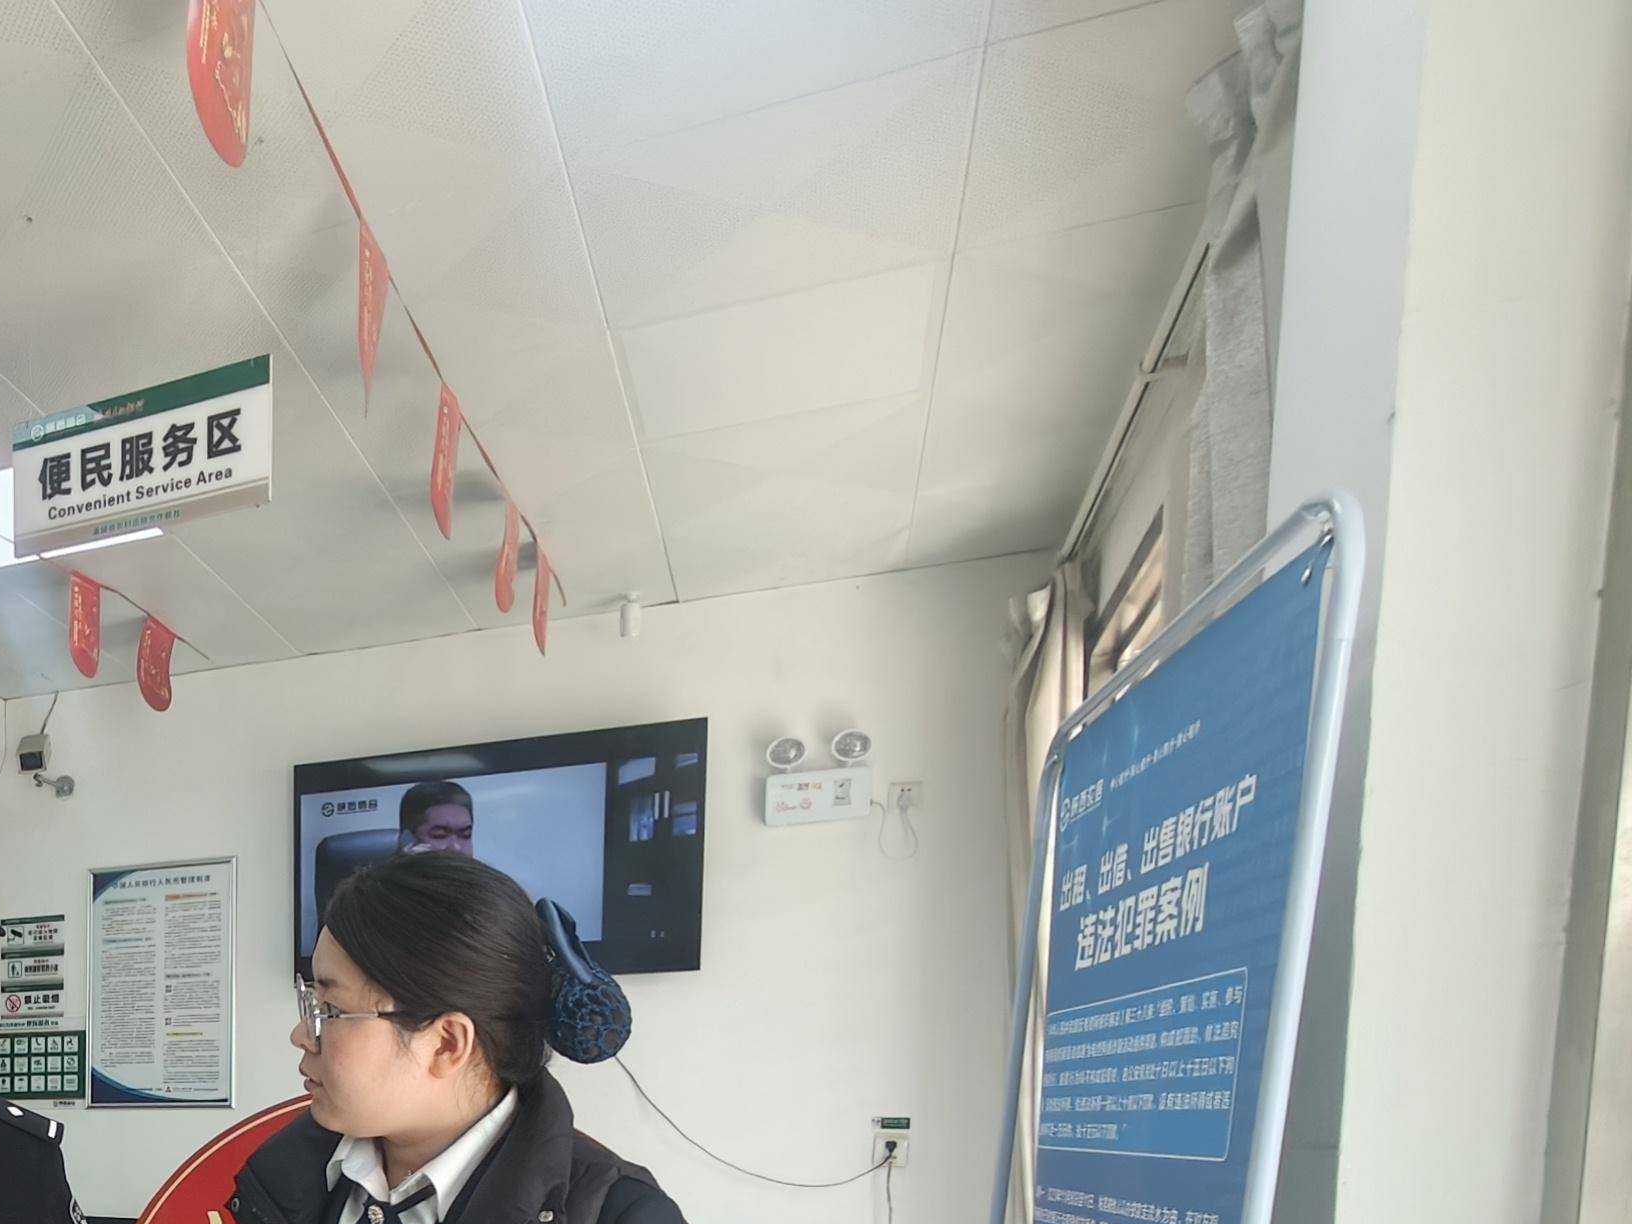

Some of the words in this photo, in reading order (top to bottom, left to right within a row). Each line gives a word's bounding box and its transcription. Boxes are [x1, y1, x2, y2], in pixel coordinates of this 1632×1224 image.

[37, 407, 242, 501] 便民服务区
[48, 491, 131, 520] Convenient
[135, 475, 192, 500] Service
[196, 465, 233, 486] Area
[1075, 862, 1210, 971] 违法犯罪案例
